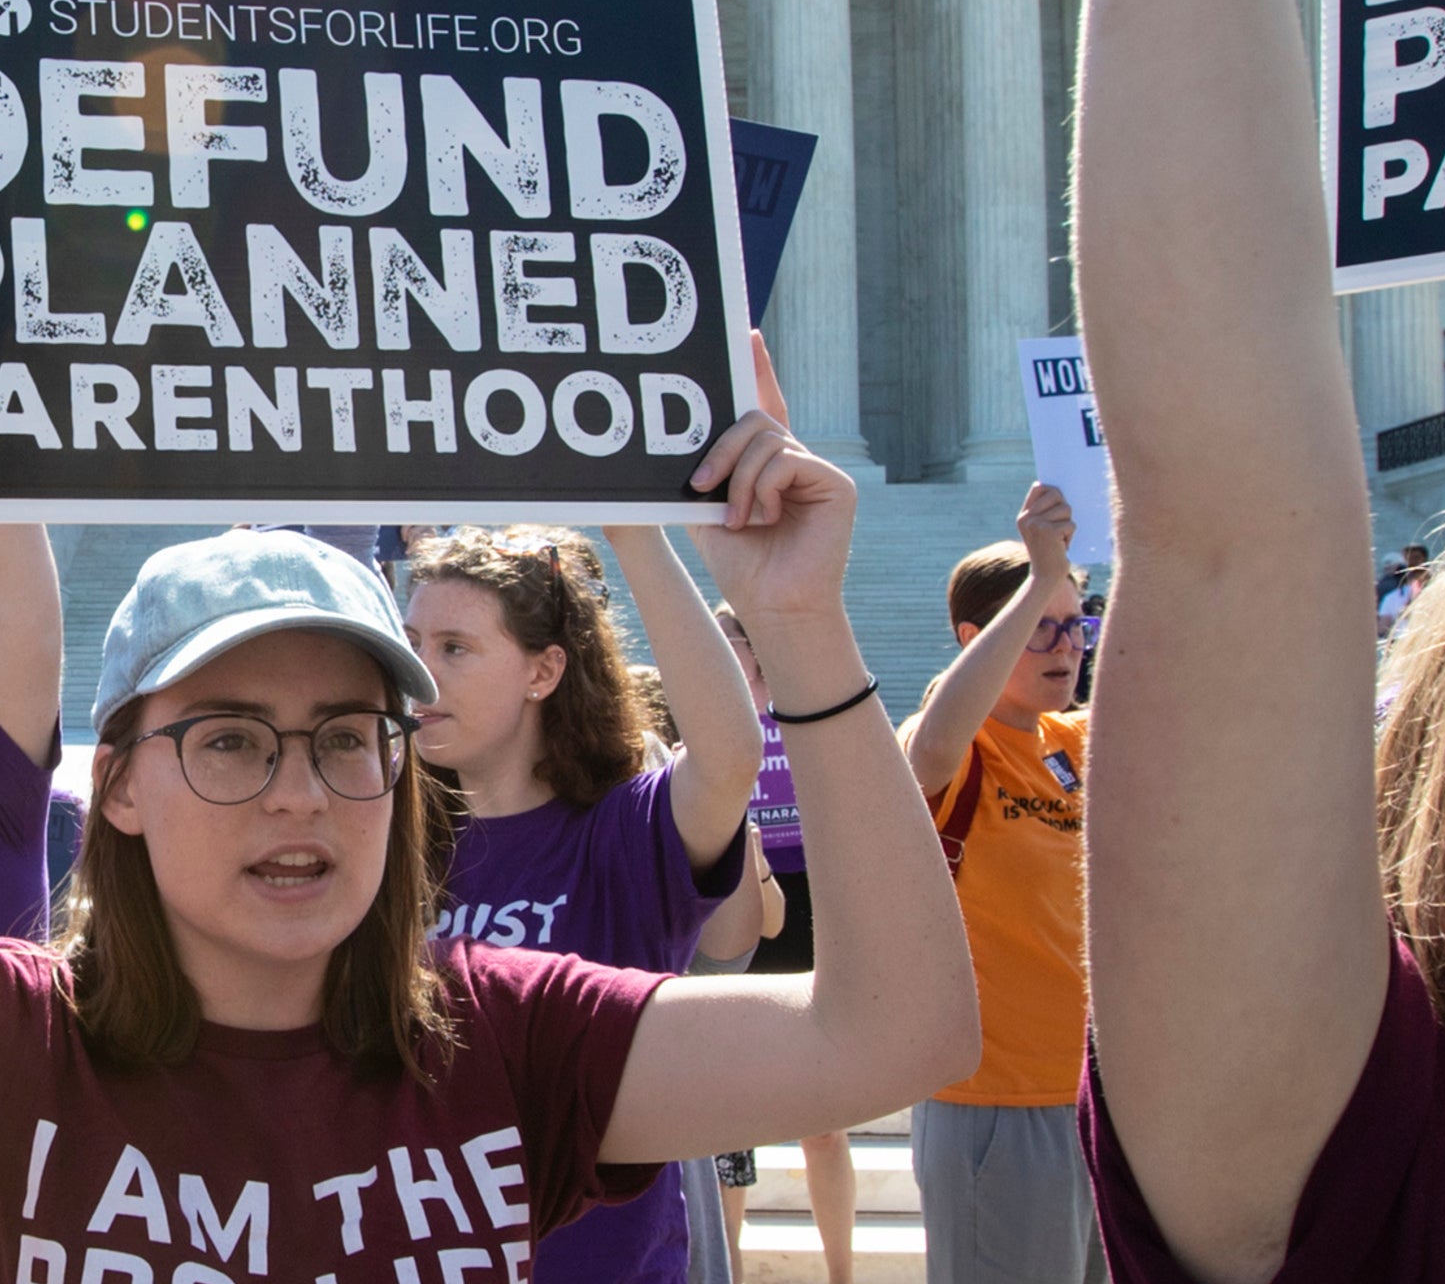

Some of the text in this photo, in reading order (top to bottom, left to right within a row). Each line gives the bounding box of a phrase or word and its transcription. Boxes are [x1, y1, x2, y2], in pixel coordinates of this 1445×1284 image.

[22, 1119, 530, 1276] I AM THE
